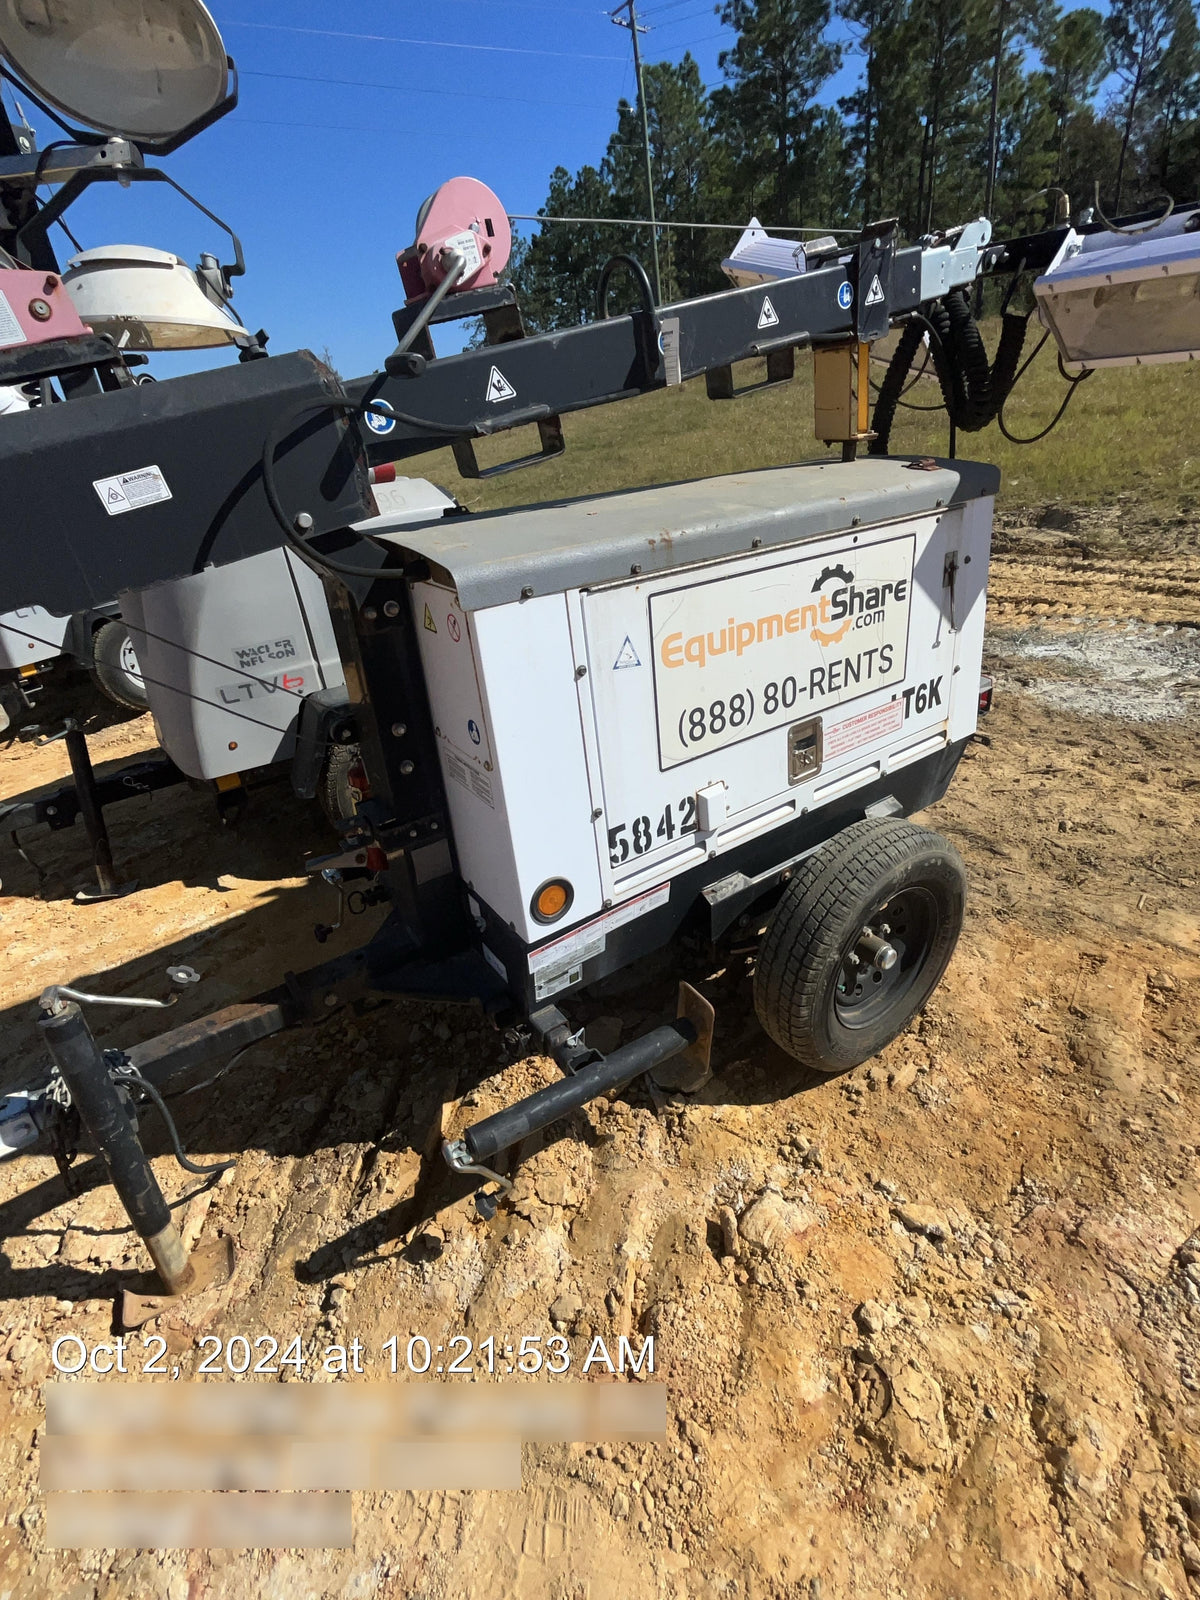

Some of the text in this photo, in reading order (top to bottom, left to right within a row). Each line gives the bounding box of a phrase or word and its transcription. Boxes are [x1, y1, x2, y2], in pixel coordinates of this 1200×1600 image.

[661, 579, 907, 669] EquipmentShare
[678, 688, 755, 748] (888)
[763, 643, 894, 715] 80-RENTS
[841, 715, 868, 730] CUSTOMER
[891, 675, 943, 719] T6K
[608, 796, 697, 863] 5842
